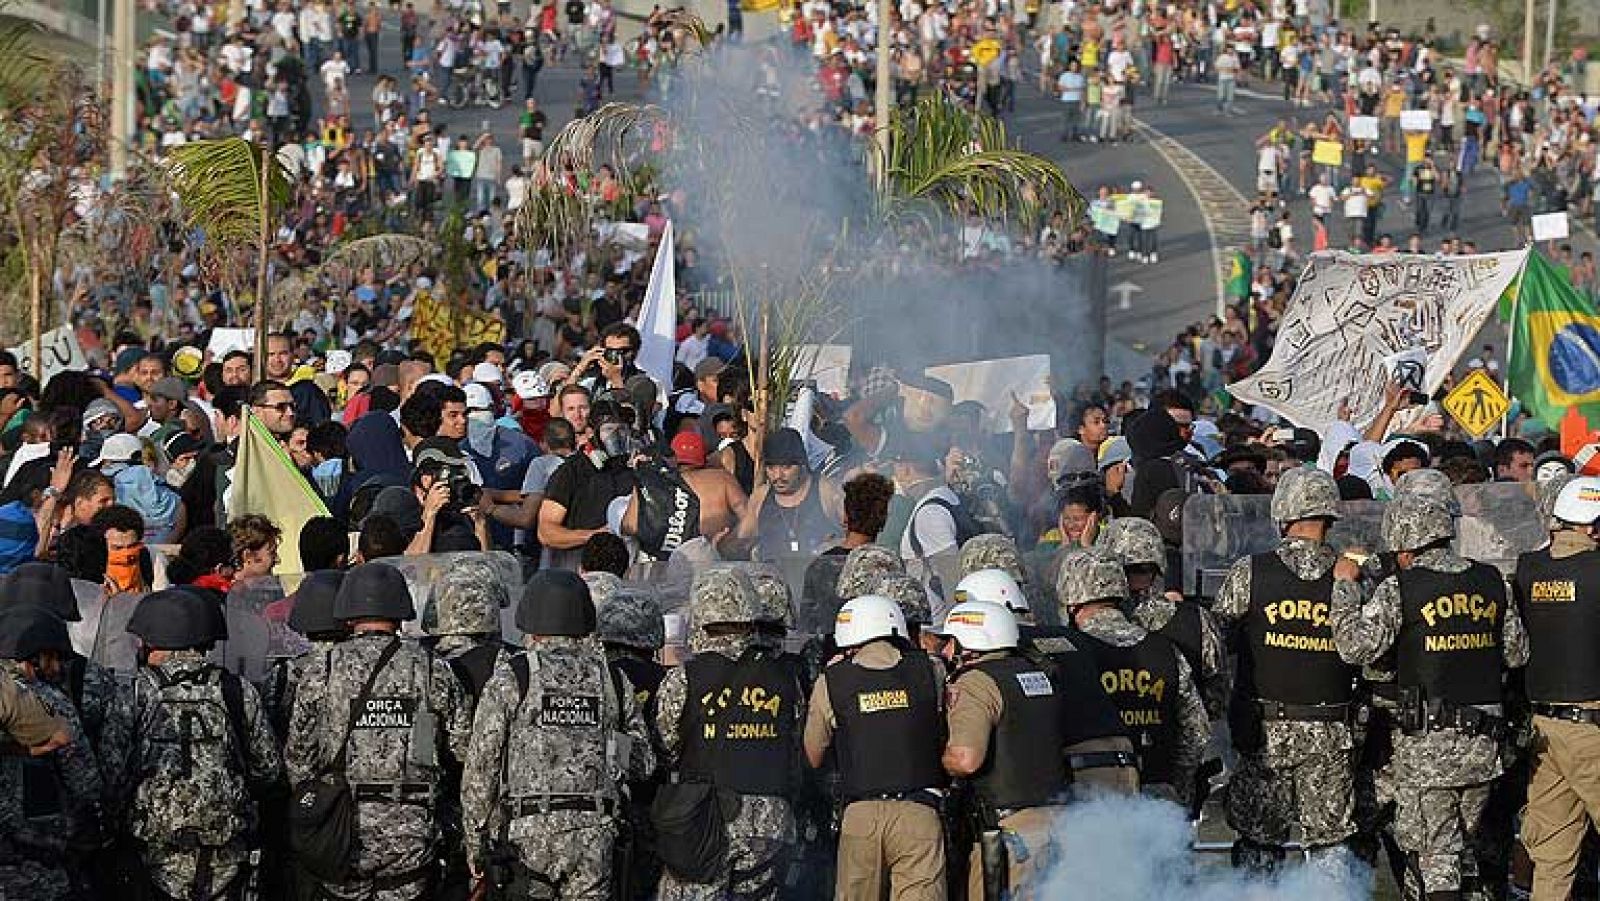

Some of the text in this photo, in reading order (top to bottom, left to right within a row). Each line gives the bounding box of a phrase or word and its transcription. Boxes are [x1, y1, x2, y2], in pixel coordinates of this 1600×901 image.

[1420, 593, 1497, 626] FORÇA
[1264, 631, 1337, 652] NACIONAL
[1424, 632, 1497, 652] NACIONAL
[1101, 668, 1165, 702] ORÇA
[366, 700, 402, 713] ORÇA
[549, 698, 590, 710] FORÇA
[356, 712, 411, 727] ACIONAL
[543, 708, 597, 725] NACIONAL
[703, 723, 778, 739] NCIONAL
